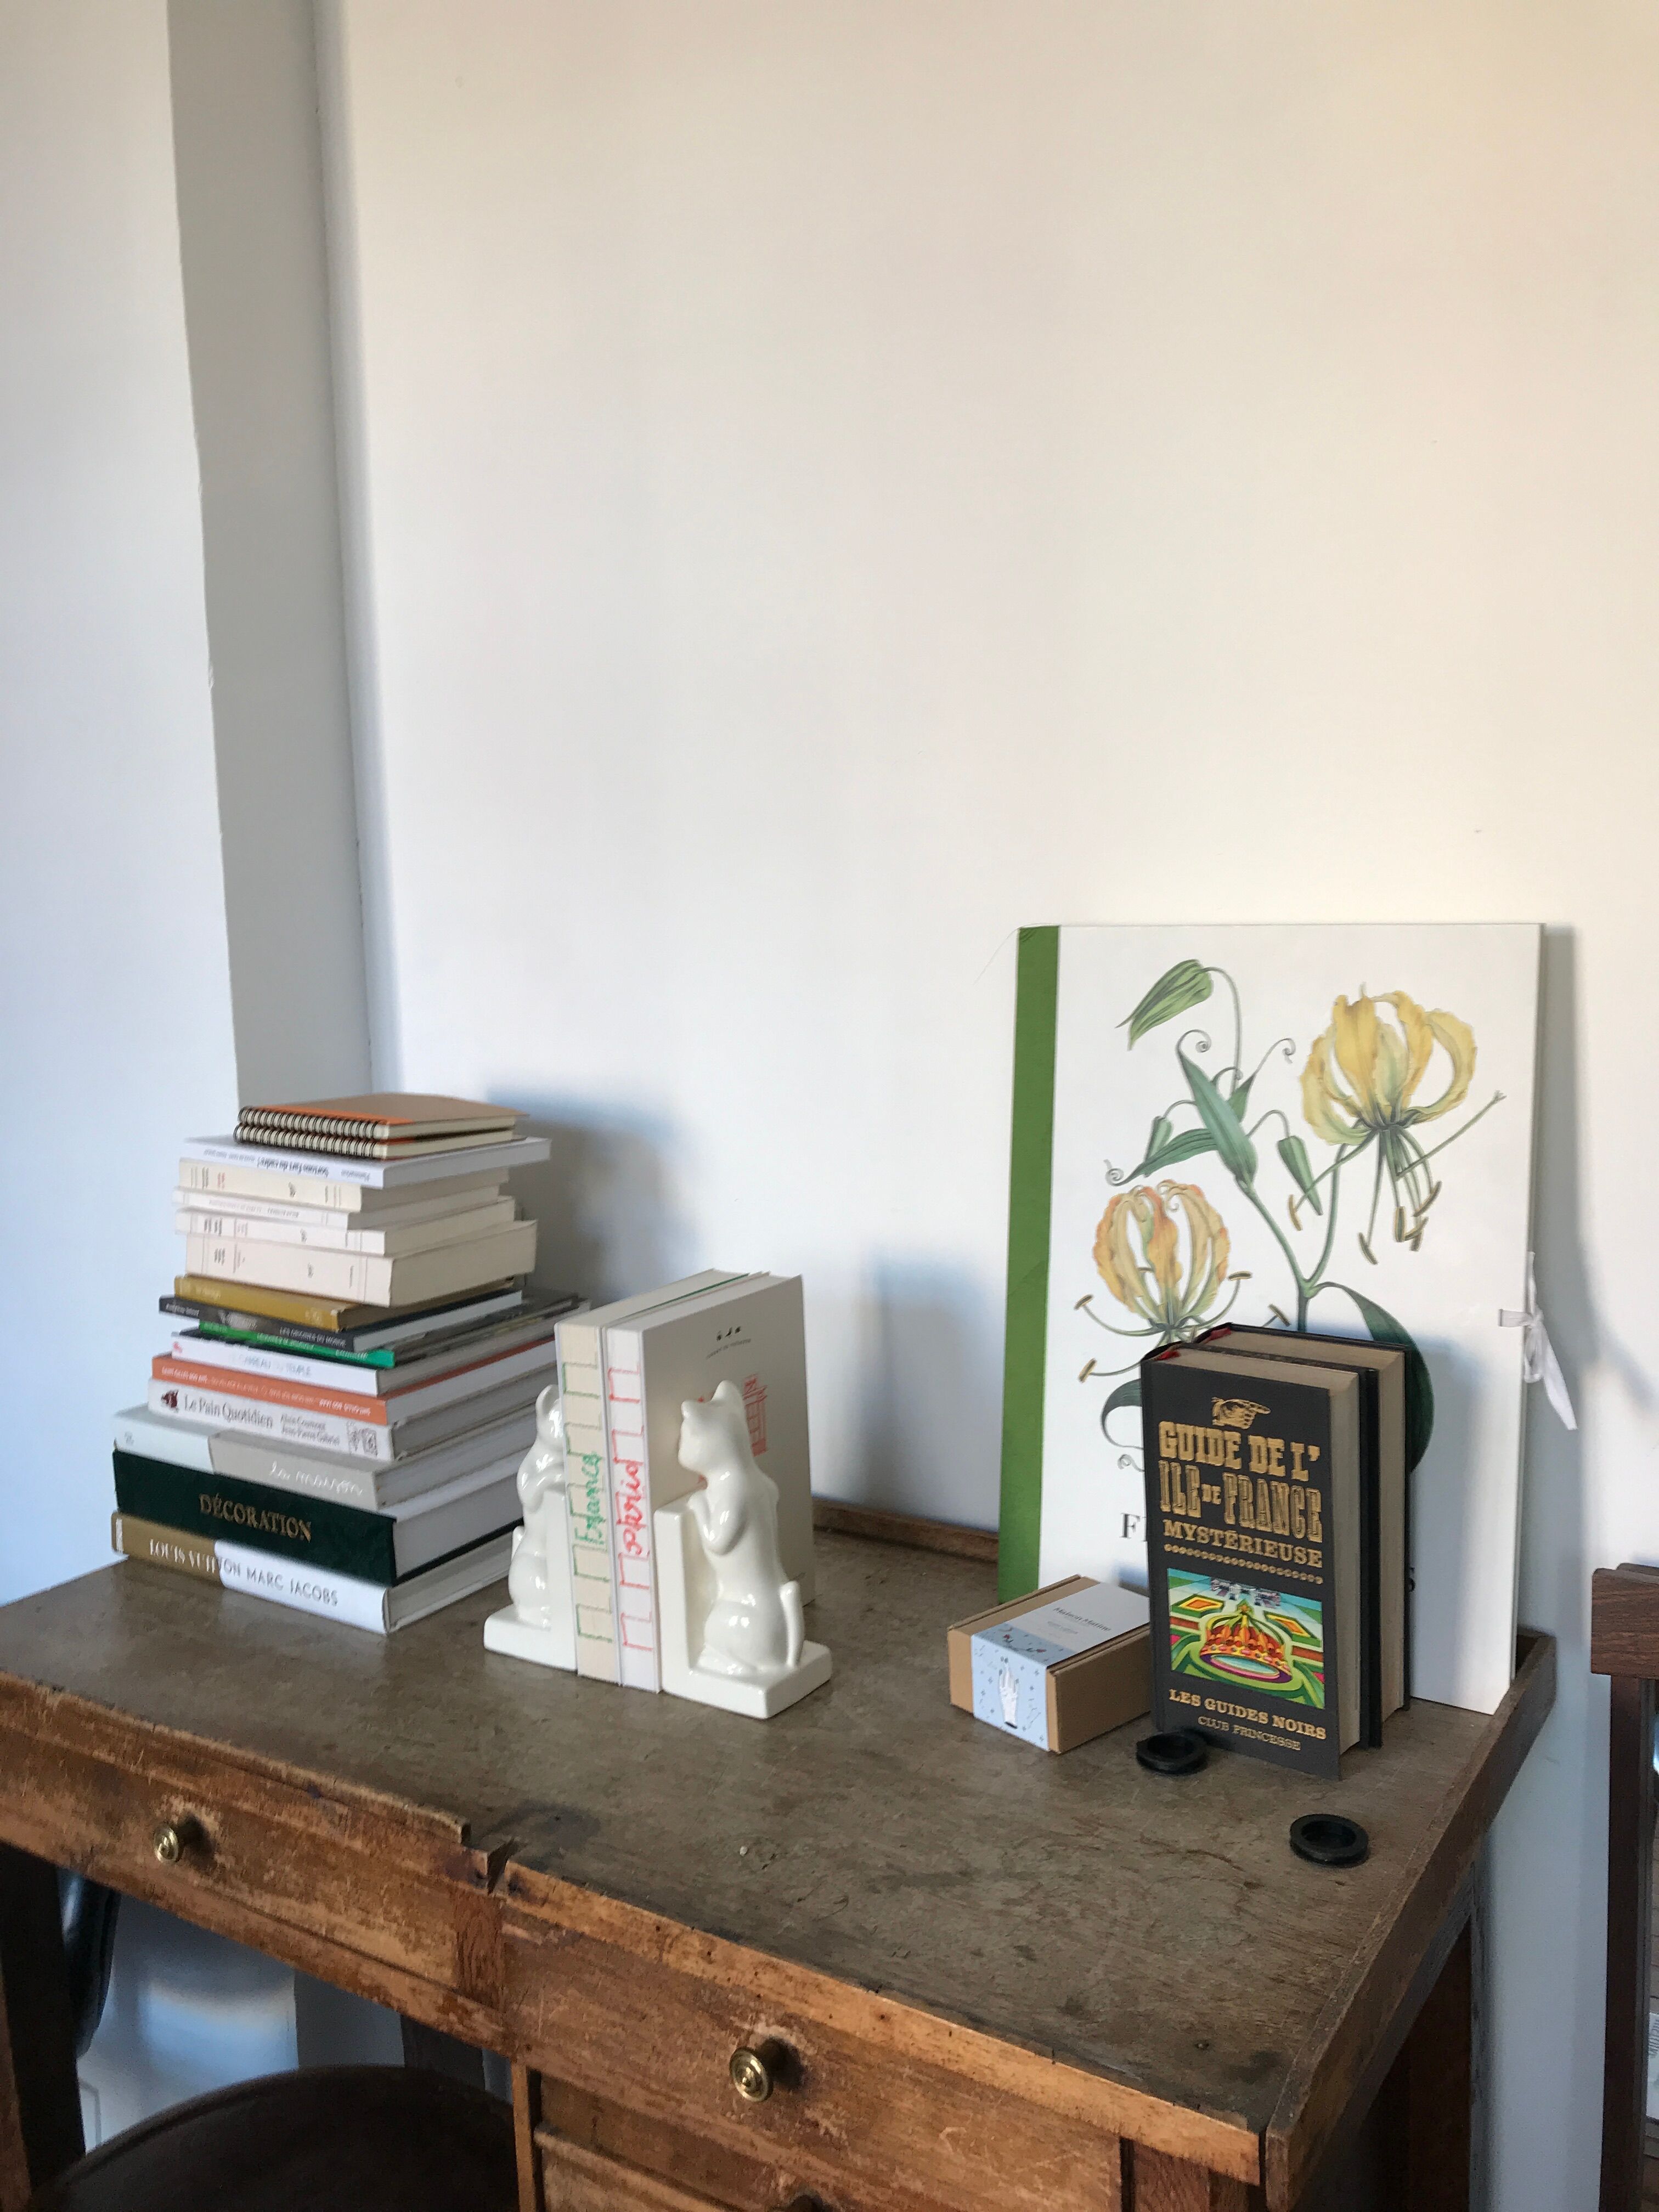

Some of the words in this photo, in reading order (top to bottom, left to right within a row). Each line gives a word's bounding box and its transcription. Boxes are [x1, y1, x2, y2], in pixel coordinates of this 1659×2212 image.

[184, 1394, 197, 1412] Le
[199, 1397, 220, 1418] Pain
[222, 1402, 273, 1429] Quotidien
[1158, 1420, 1242, 1470] GUIDE
[1248, 1435, 1286, 1477] DE
[1290, 1441, 1321, 1481] L'
[199, 1492, 312, 1543] DÉCORATION
[1158, 1460, 1201, 1518] ILE
[1201, 1483, 1222, 1505] DE
[1222, 1472, 1323, 1543] FRANCE
[1162, 1519, 1323, 1568] MYSTÉRIEUSE
[149, 1538, 185, 1564] LOUIS
[188, 1549, 241, 1577] VUITTON
[246, 1565, 284, 1591] MARC
[290, 1578, 338, 1607] JACOBS
[1169, 1689, 1201, 1707] LES
[1204, 1698, 1269, 1724] GUIDES
[1271, 1714, 1327, 1740] NOIRS
[1197, 1716, 1230, 1731] CLUB
[1233, 1724, 1302, 1751] PRINCESSE
